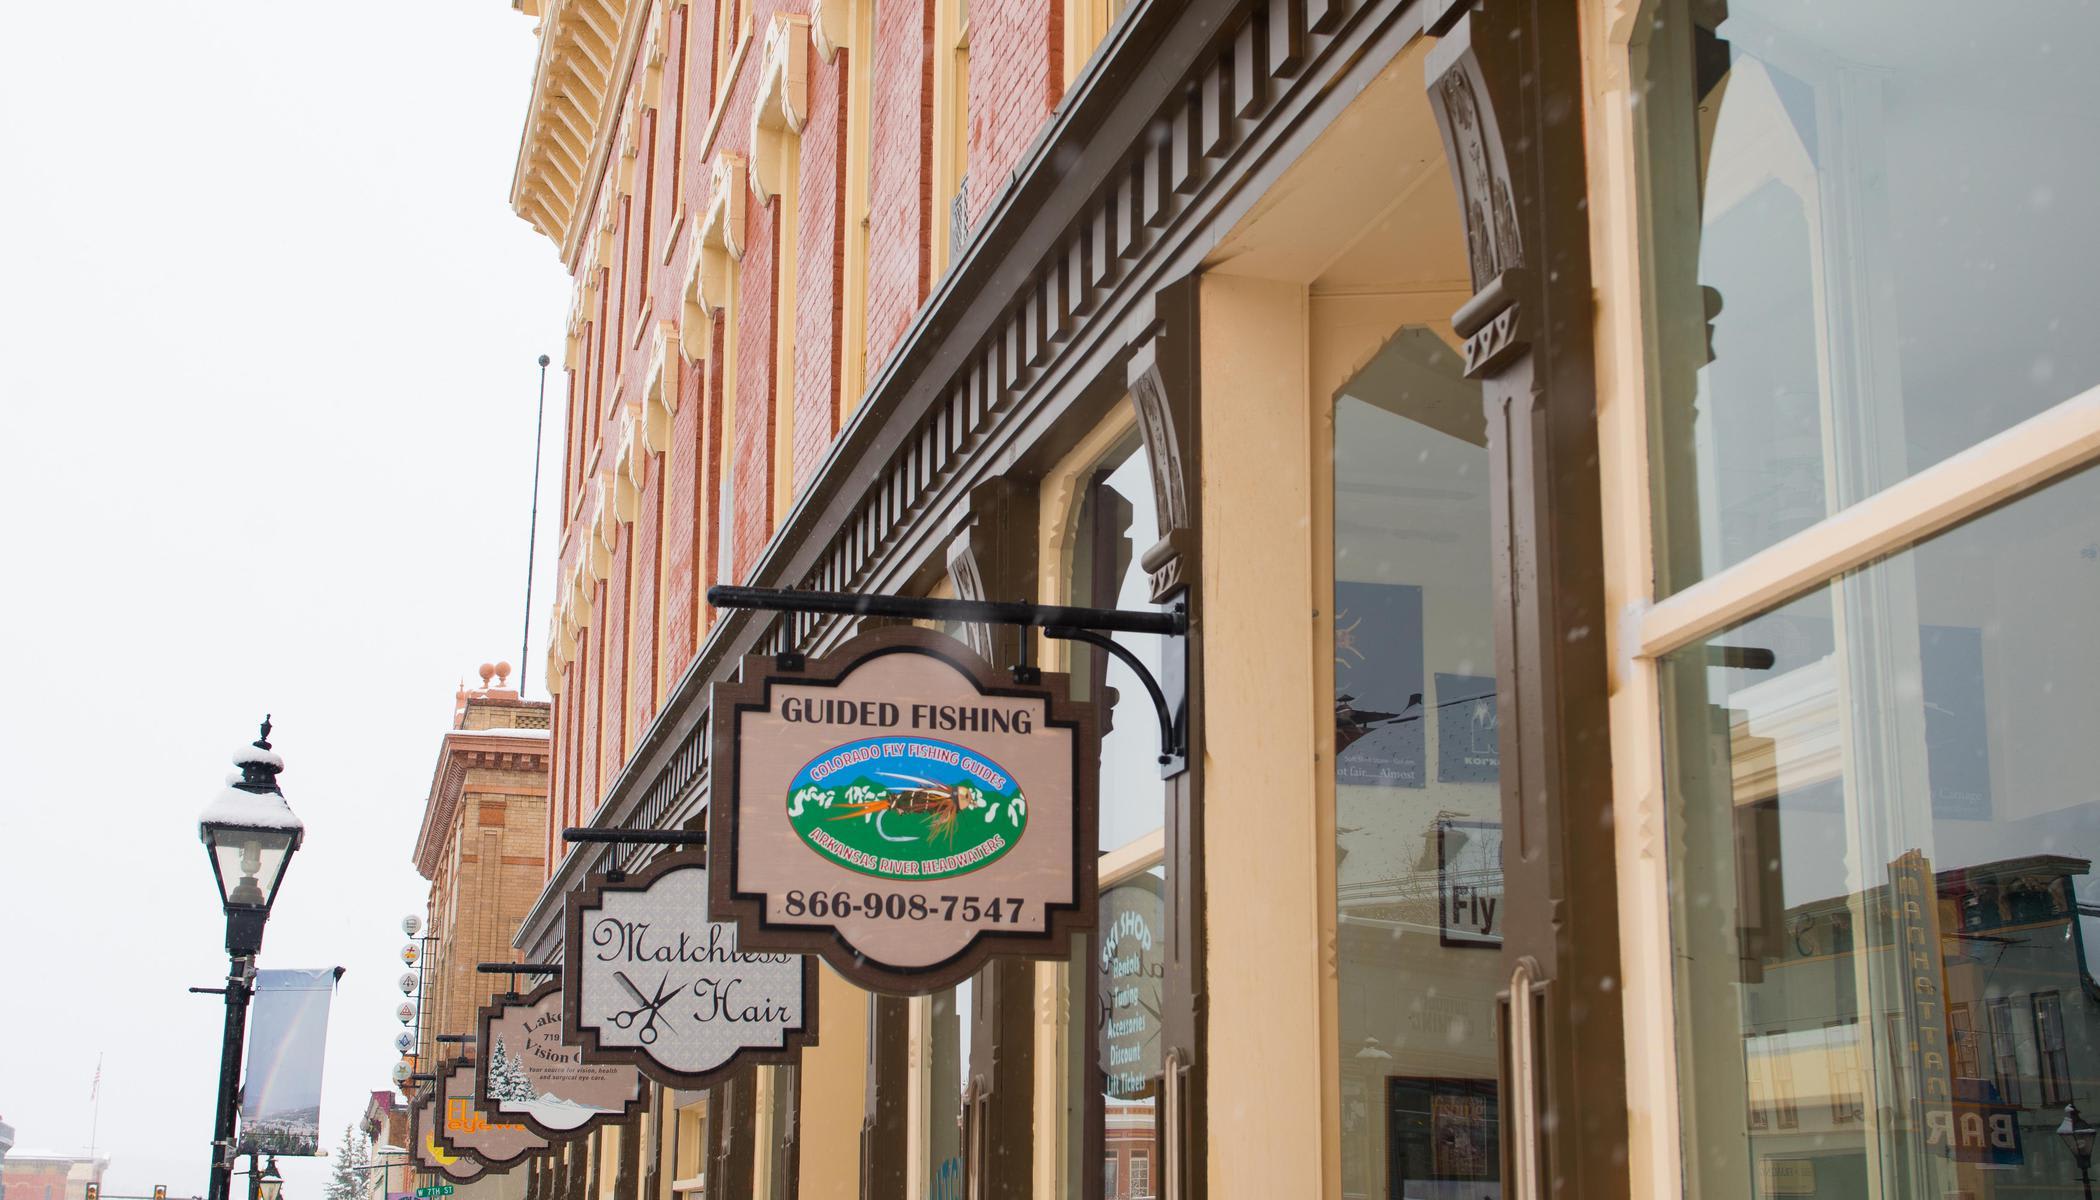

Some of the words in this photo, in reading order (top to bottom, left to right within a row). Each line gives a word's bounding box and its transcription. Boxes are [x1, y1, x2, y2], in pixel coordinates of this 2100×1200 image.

[782, 697, 899, 727] GUIDED
[911, 703, 1032, 735] FISHING
[810, 744, 881, 782] COLORADO
[882, 743, 906, 757] FLY
[908, 744, 960, 766] FISHING
[961, 757, 1006, 791] GUIDES
[808, 826, 877, 870] ARKANSAS
[879, 858, 920, 875] RIVER
[921, 834, 1006, 875] HEADWATERS
[785, 890, 1025, 924] 866-908-7547
[1452, 885, 1497, 935] Fly
[1120, 910, 1152, 951] SHOP
[1113, 952, 1140, 978] Rentals
[693, 977, 792, 1023] Hair
[1114, 985, 1139, 1009] Tuning
[1107, 1014, 1146, 1040] Accessories
[525, 1038, 569, 1063] Vision
[1110, 1042, 1141, 1066] Discount
[1120, 1071, 1146, 1095] Tickets
[444, 1186, 452, 1194] ST
